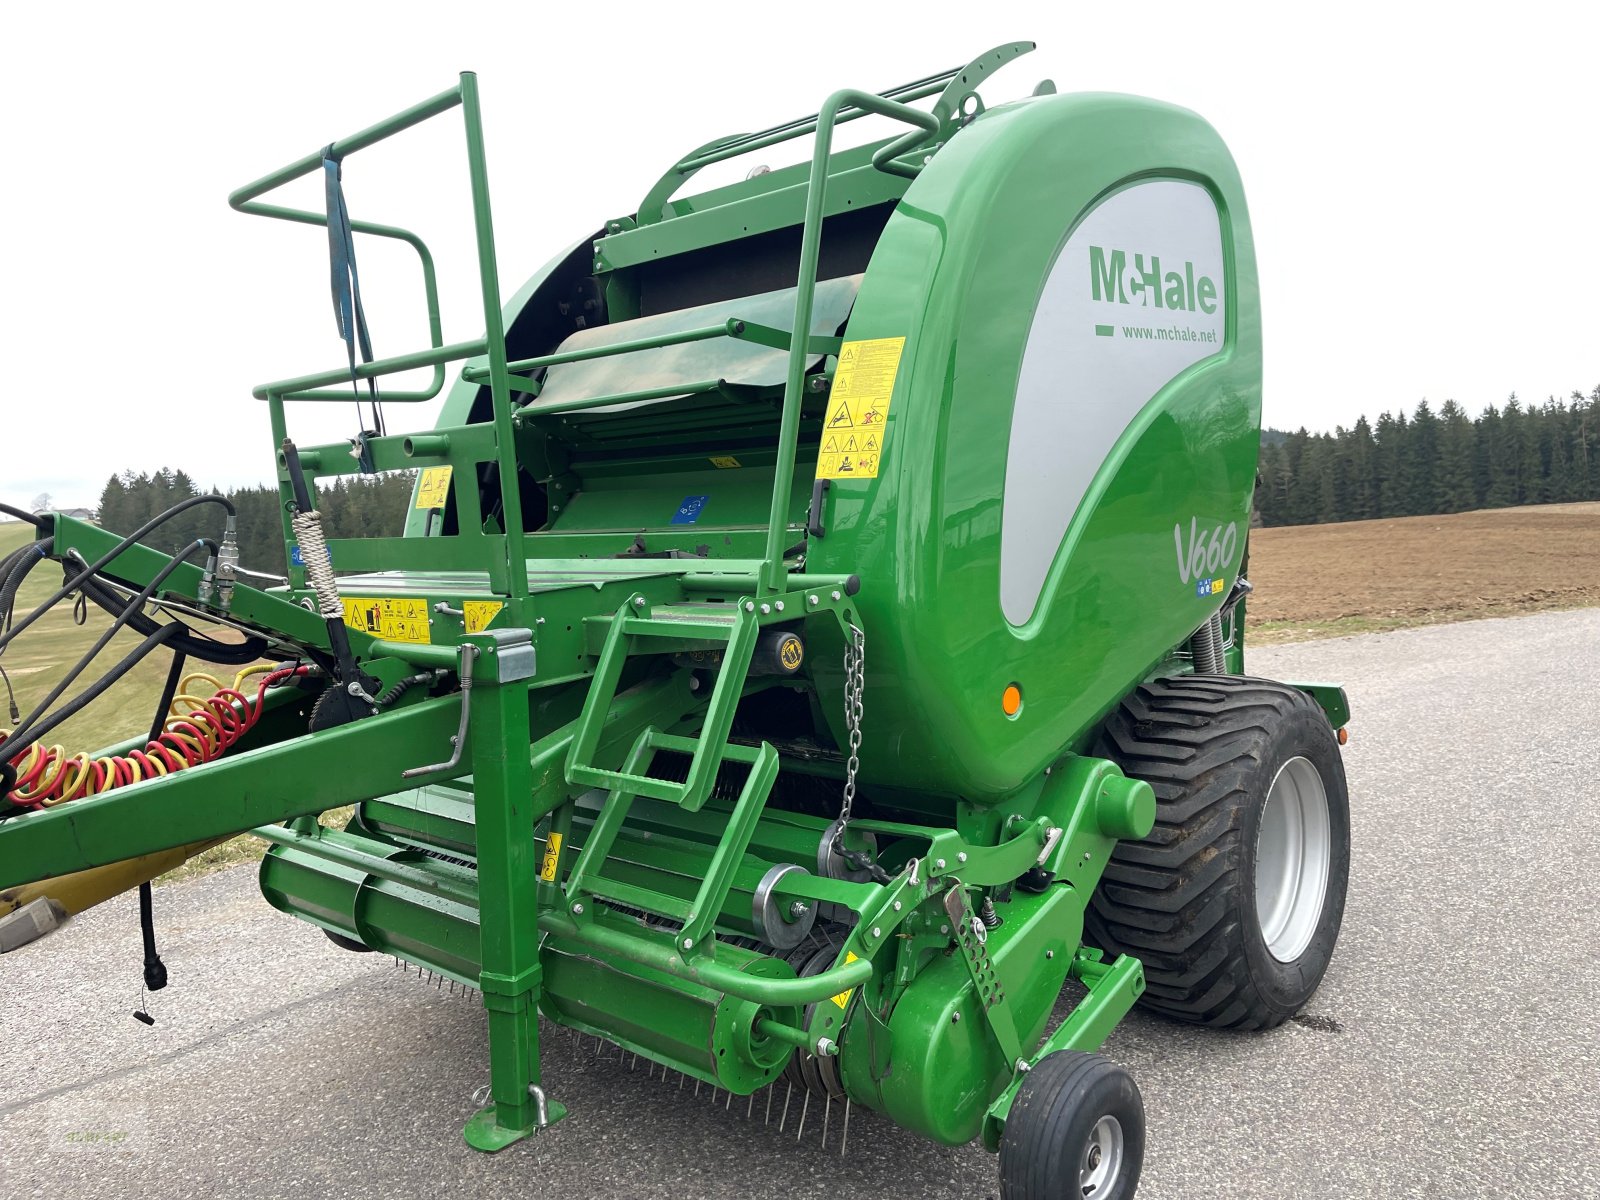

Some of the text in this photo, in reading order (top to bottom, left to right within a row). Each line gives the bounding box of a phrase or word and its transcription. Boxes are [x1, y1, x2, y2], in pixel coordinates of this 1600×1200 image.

[1089, 245, 1217, 315] McHale
[1122, 326, 1217, 343] www.mchale.net
[1174, 515, 1237, 585] V660
